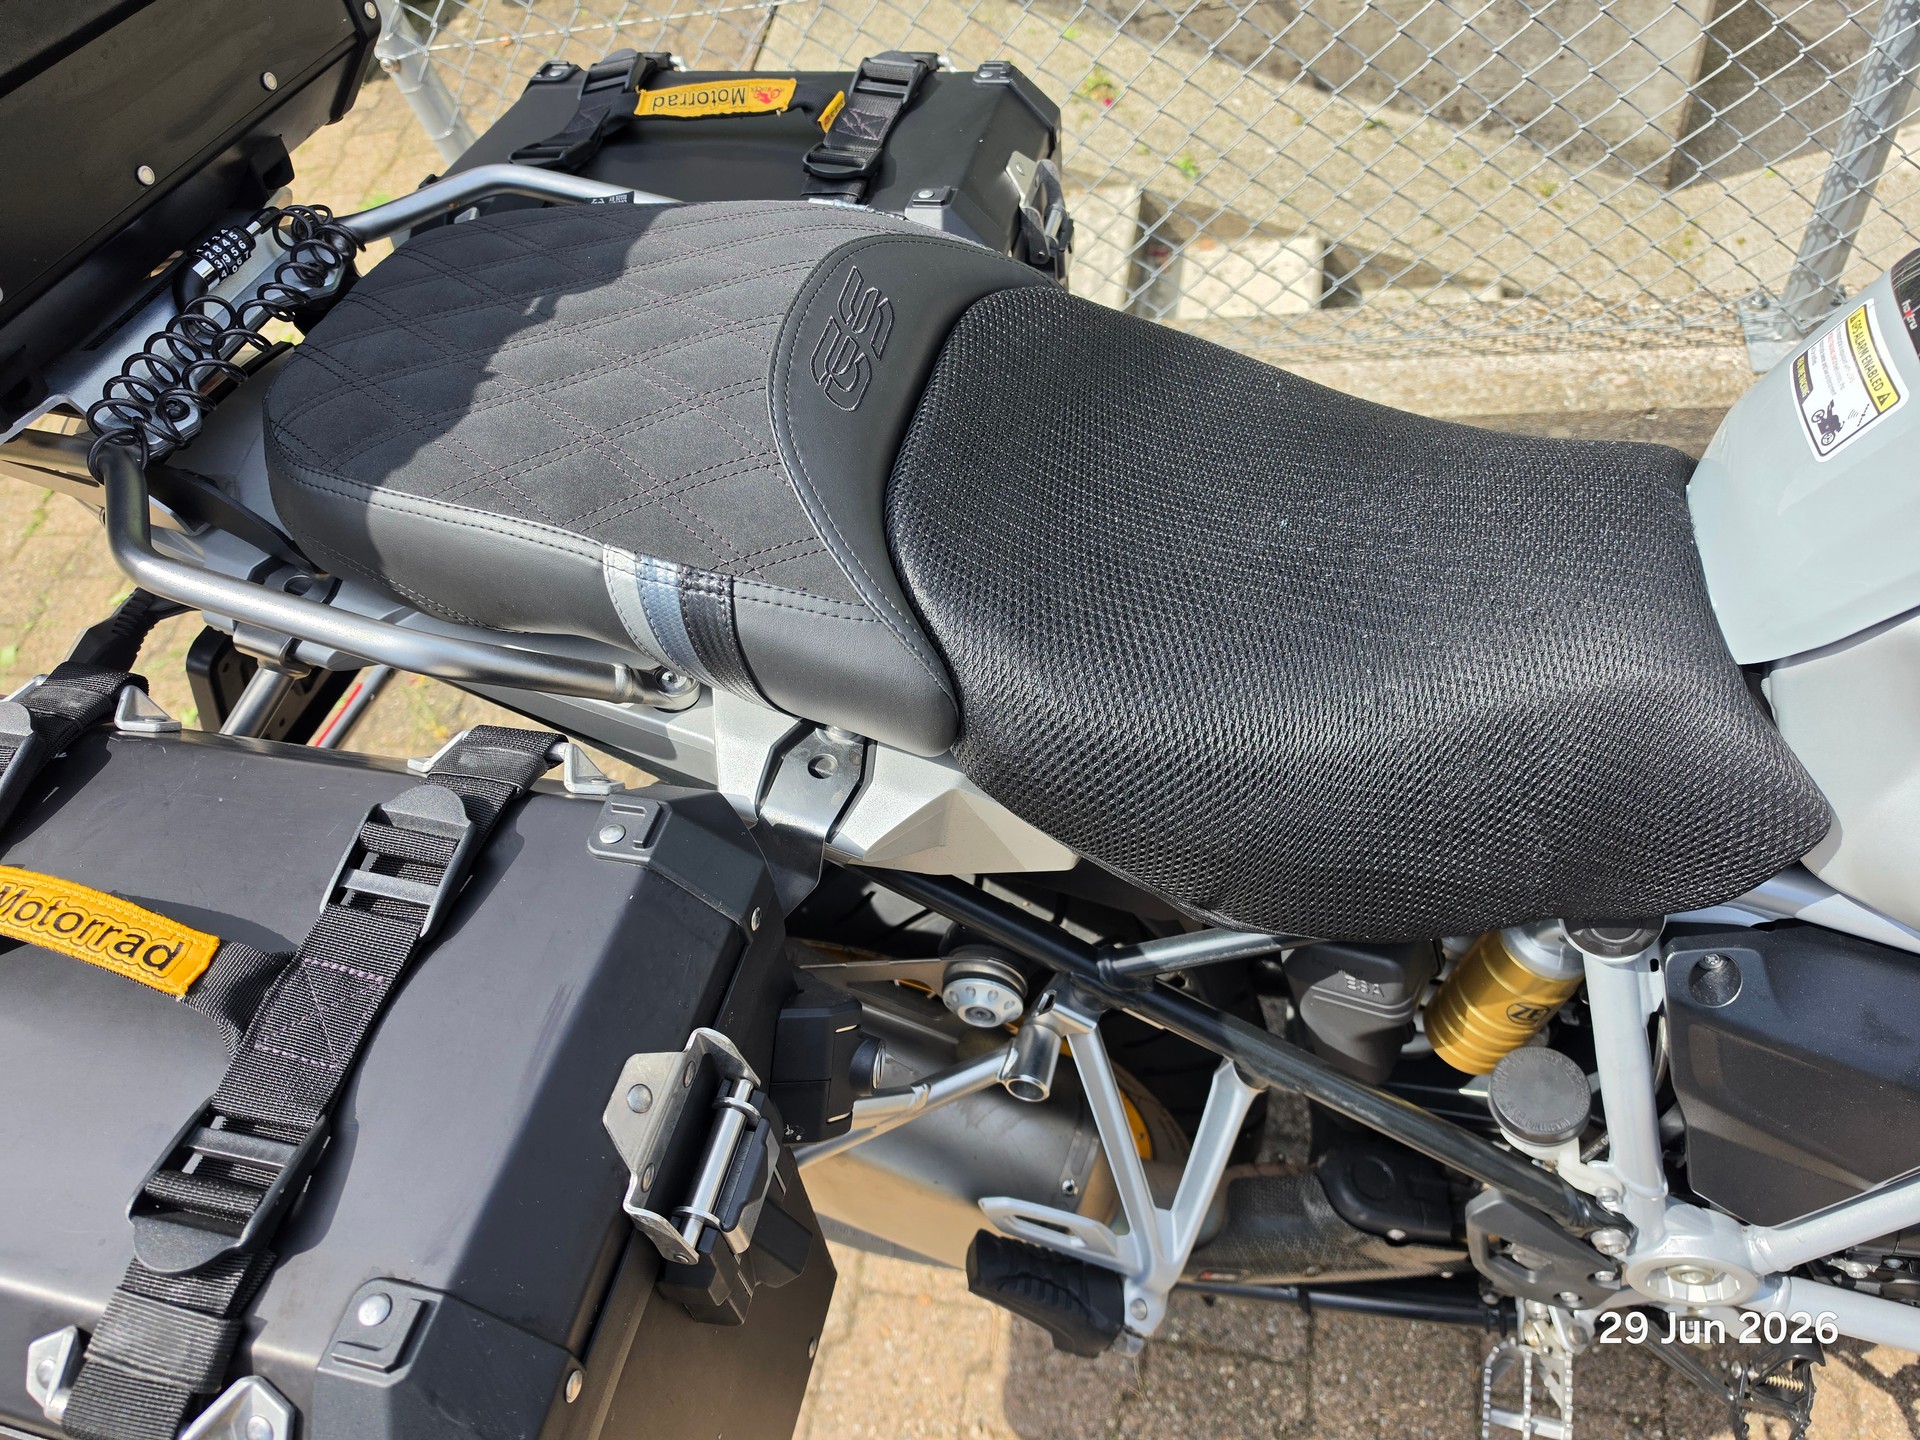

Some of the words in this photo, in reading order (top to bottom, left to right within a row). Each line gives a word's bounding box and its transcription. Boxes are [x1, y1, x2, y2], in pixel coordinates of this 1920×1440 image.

[652, 87, 746, 111] Motorrad
[1851, 319, 1863, 335] GPS
[1853, 331, 1870, 359] ALARM
[1861, 354, 1884, 392] ENABLED
[0, 885, 186, 971] Motorrad
